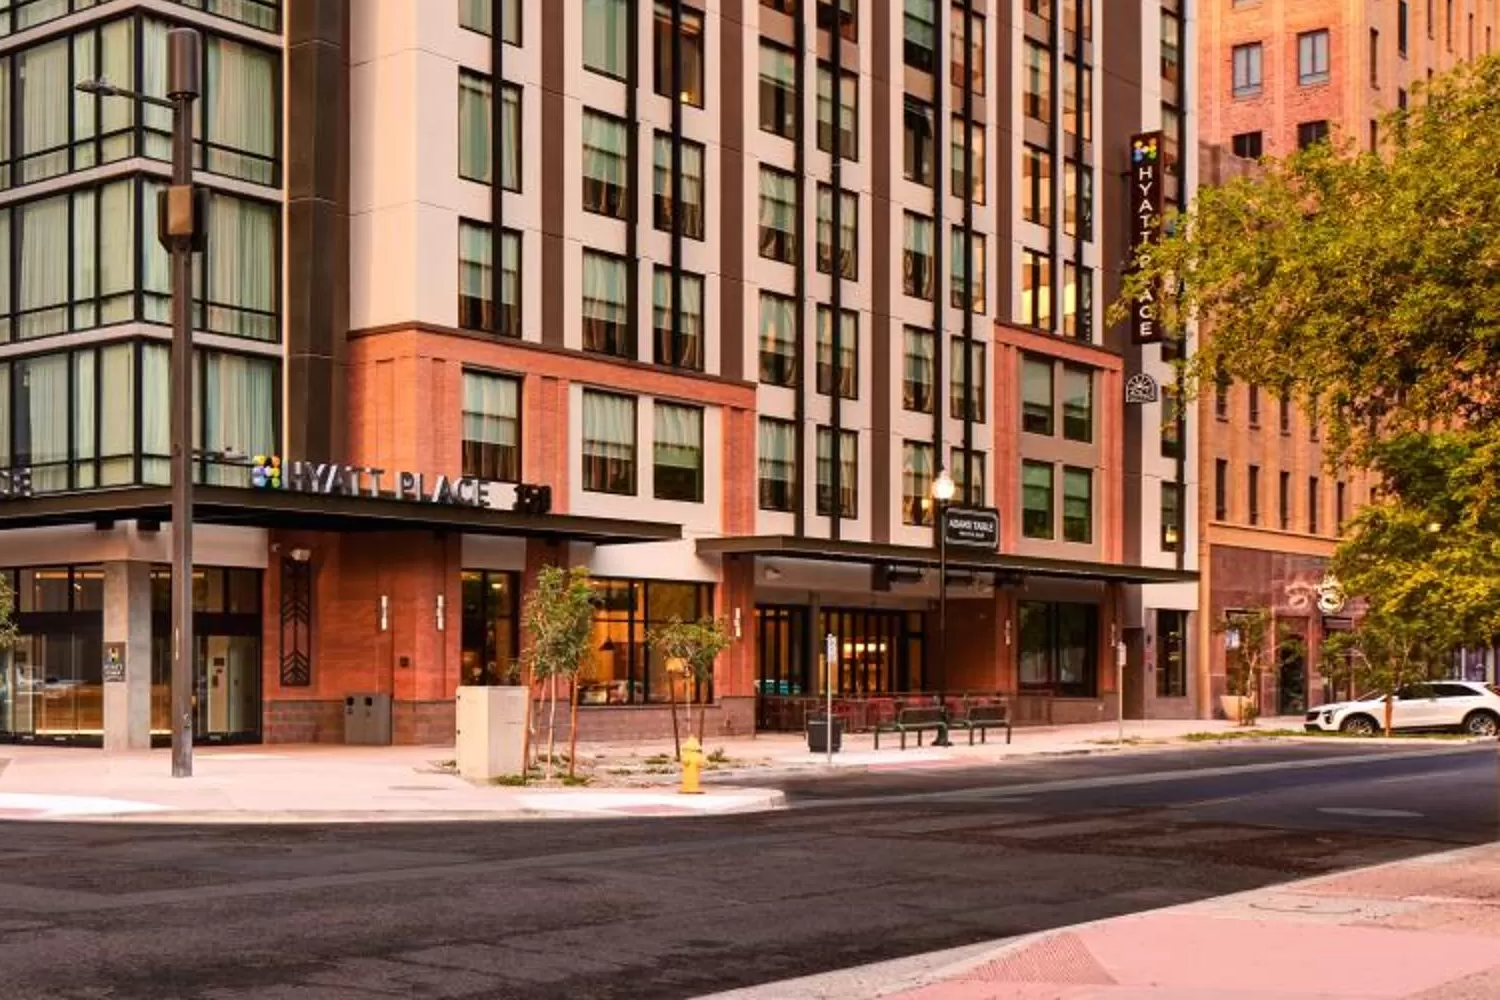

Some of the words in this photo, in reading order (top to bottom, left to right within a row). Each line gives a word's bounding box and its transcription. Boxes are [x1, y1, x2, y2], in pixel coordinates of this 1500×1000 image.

[1138, 166, 1154, 245] HYATT
[1138, 253, 1154, 336] PACE
[283, 459, 385, 498] HYATT
[395, 472, 491, 507] PLACE
